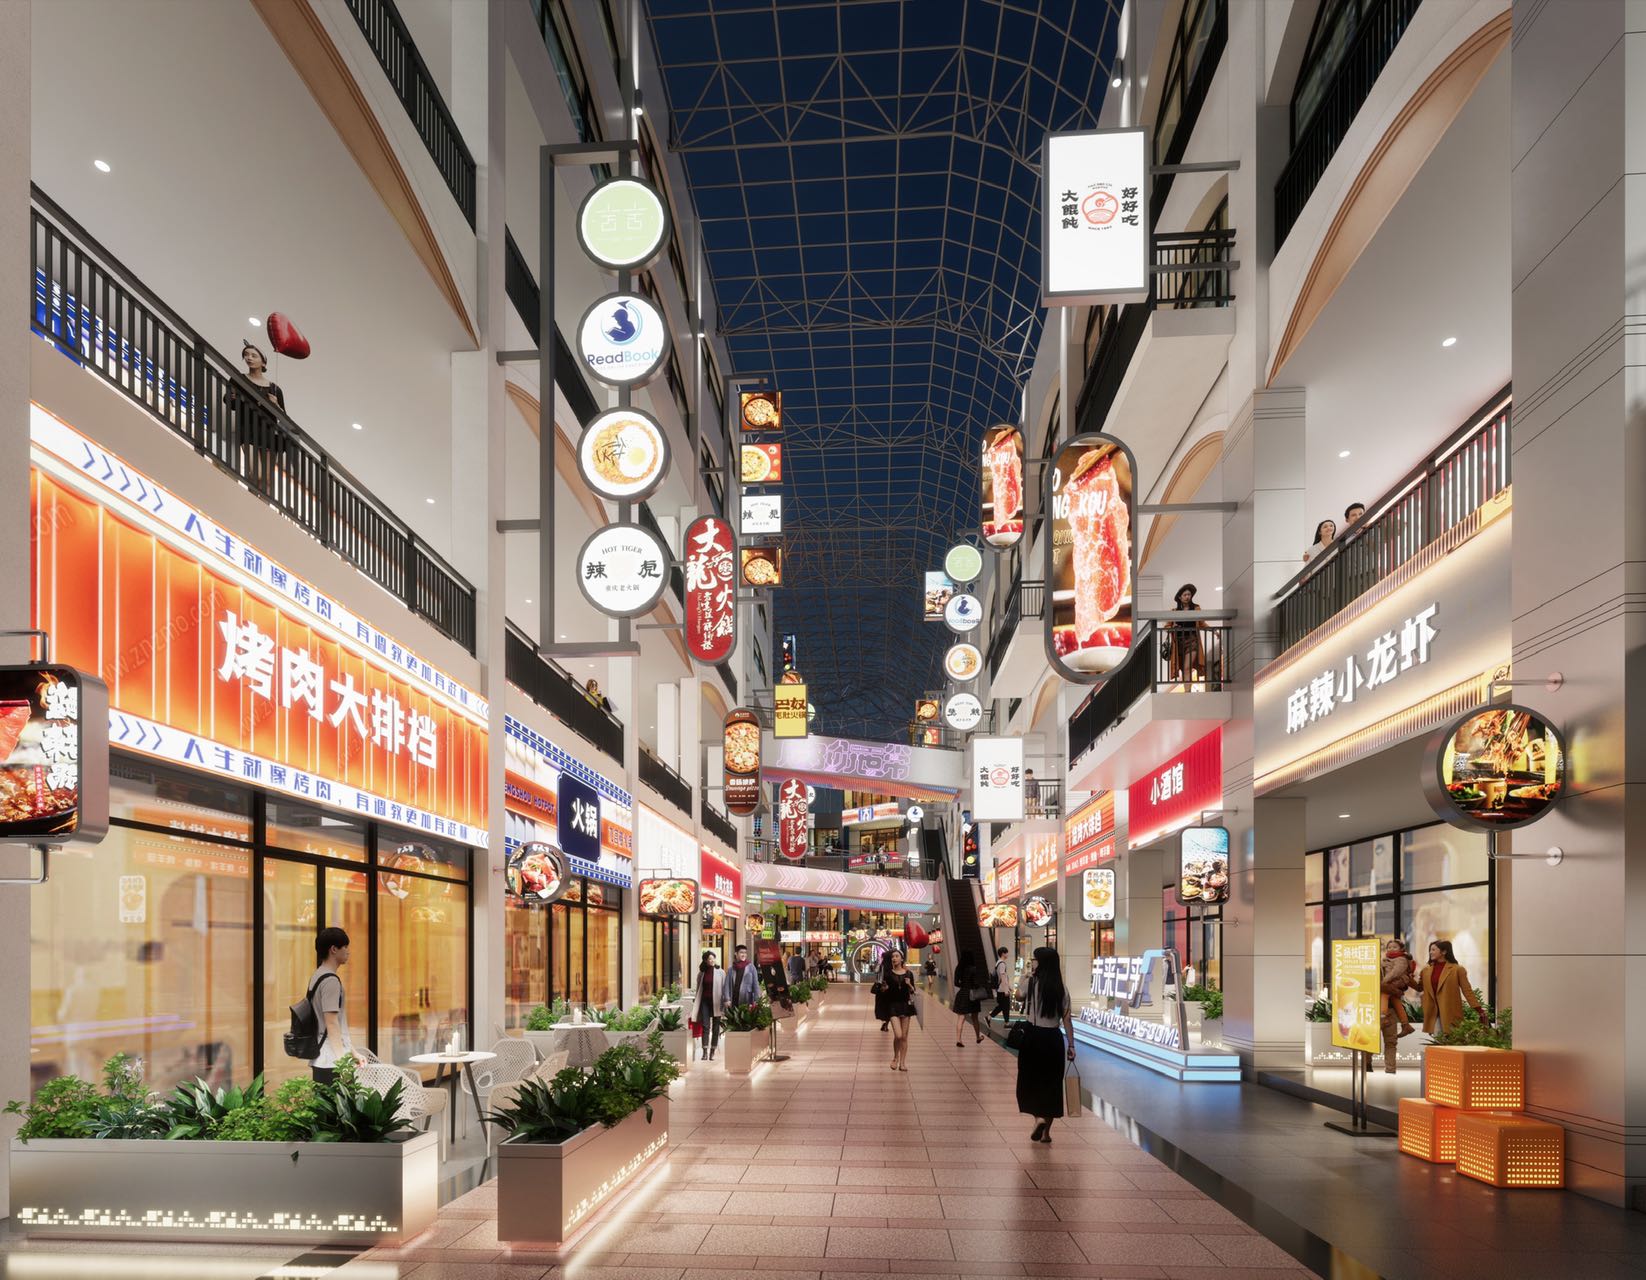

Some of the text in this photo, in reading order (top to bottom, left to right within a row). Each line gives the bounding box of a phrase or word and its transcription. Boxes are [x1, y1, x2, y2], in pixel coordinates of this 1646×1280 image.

[1121, 187, 1139, 227] 好好吃
[586, 349, 659, 366] ReadBook
[585, 560, 661, 580] 辣 虎
[602, 545, 643, 555] HOT TIGER
[1286, 601, 1439, 734] 麻辣小龙虾
[218, 609, 437, 769] 烤肉大排档
[775, 697, 807, 710] 巴奴
[1150, 761, 1184, 805] 小酒馆
[571, 797, 598, 839] 火锅
